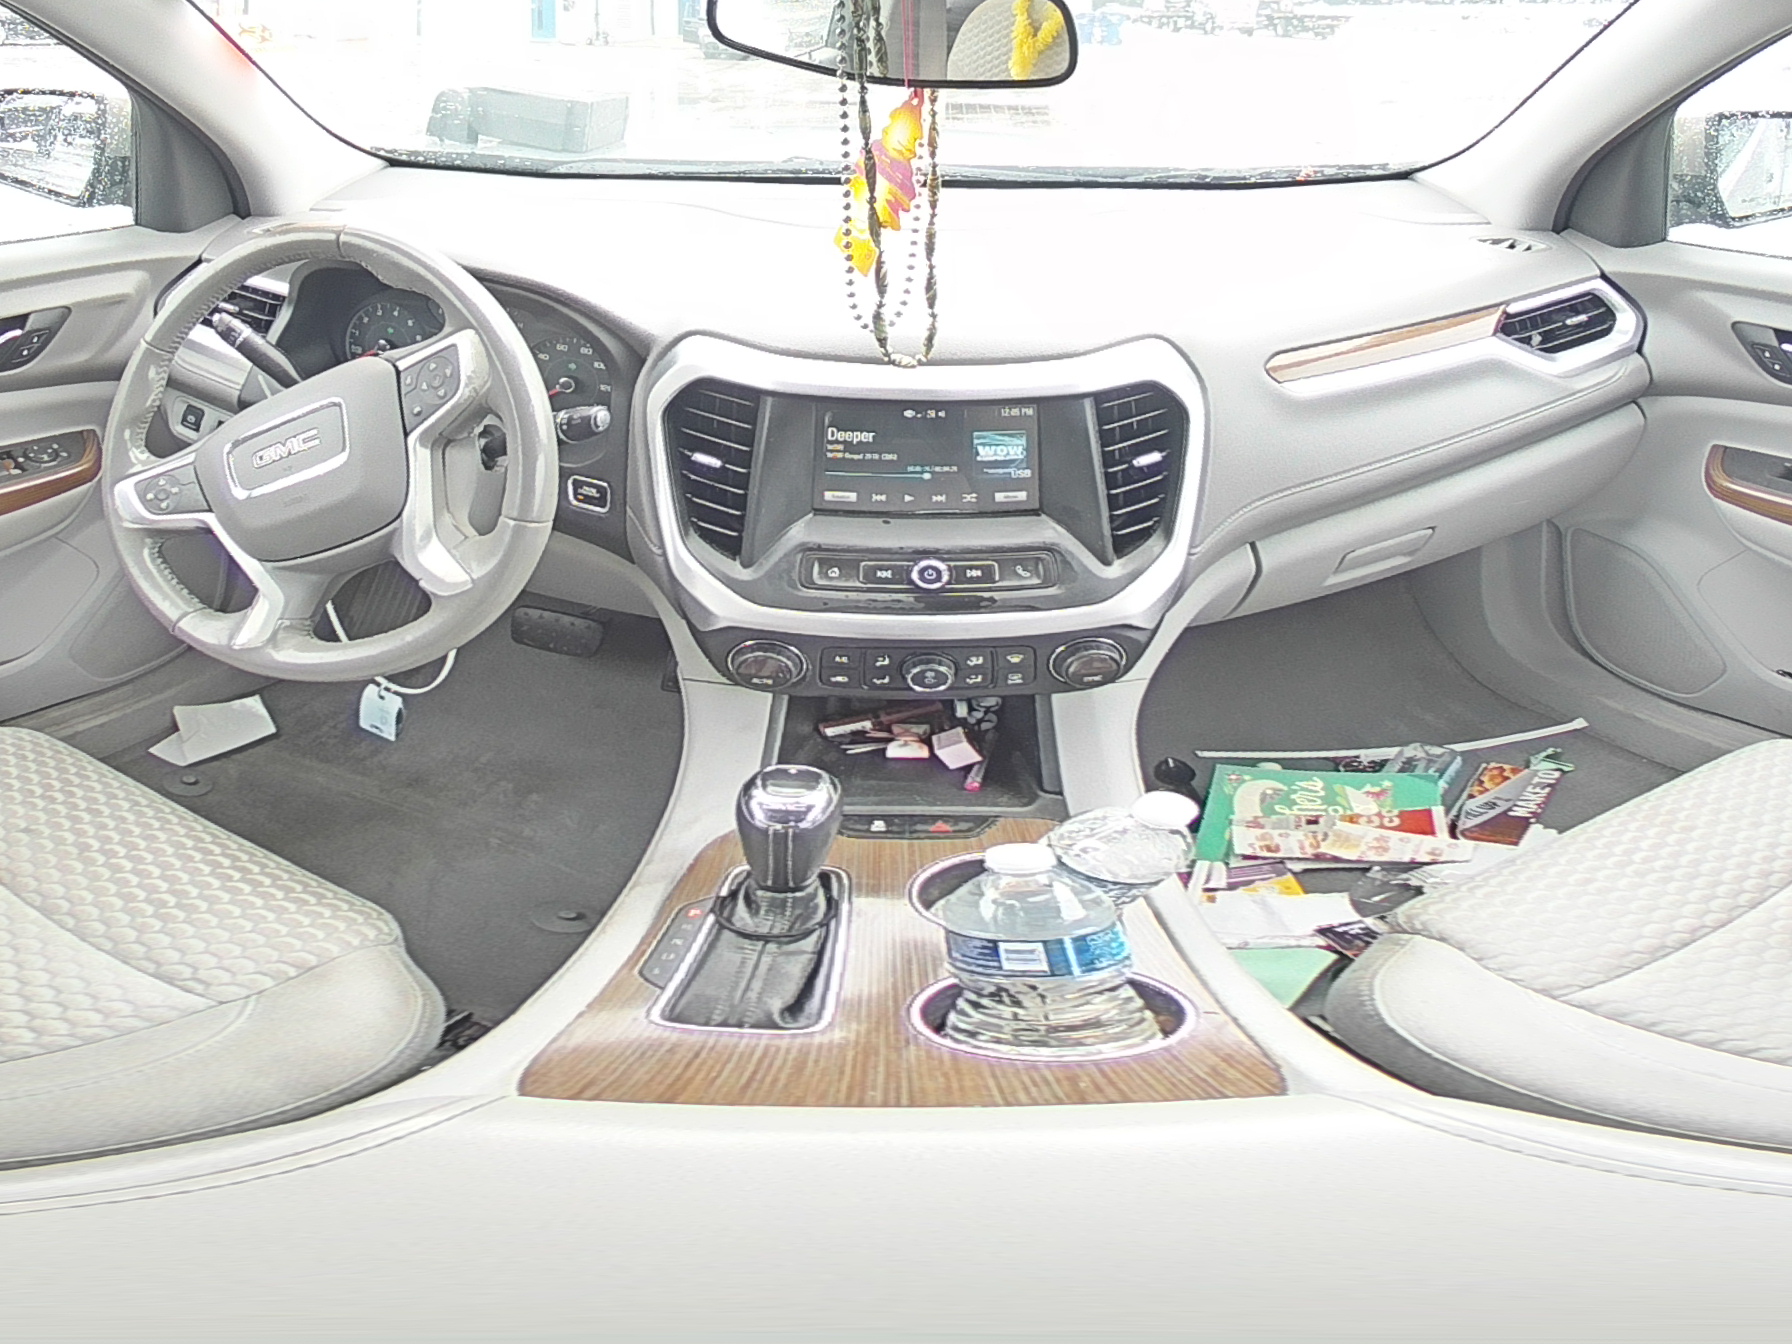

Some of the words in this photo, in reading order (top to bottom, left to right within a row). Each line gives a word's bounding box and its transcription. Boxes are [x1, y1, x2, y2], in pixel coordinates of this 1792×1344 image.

[252, 427, 322, 469] GMC
[827, 427, 875, 443] Deeper
[1507, 785, 1552, 818] MAKE
[1531, 769, 1563, 785] TO
